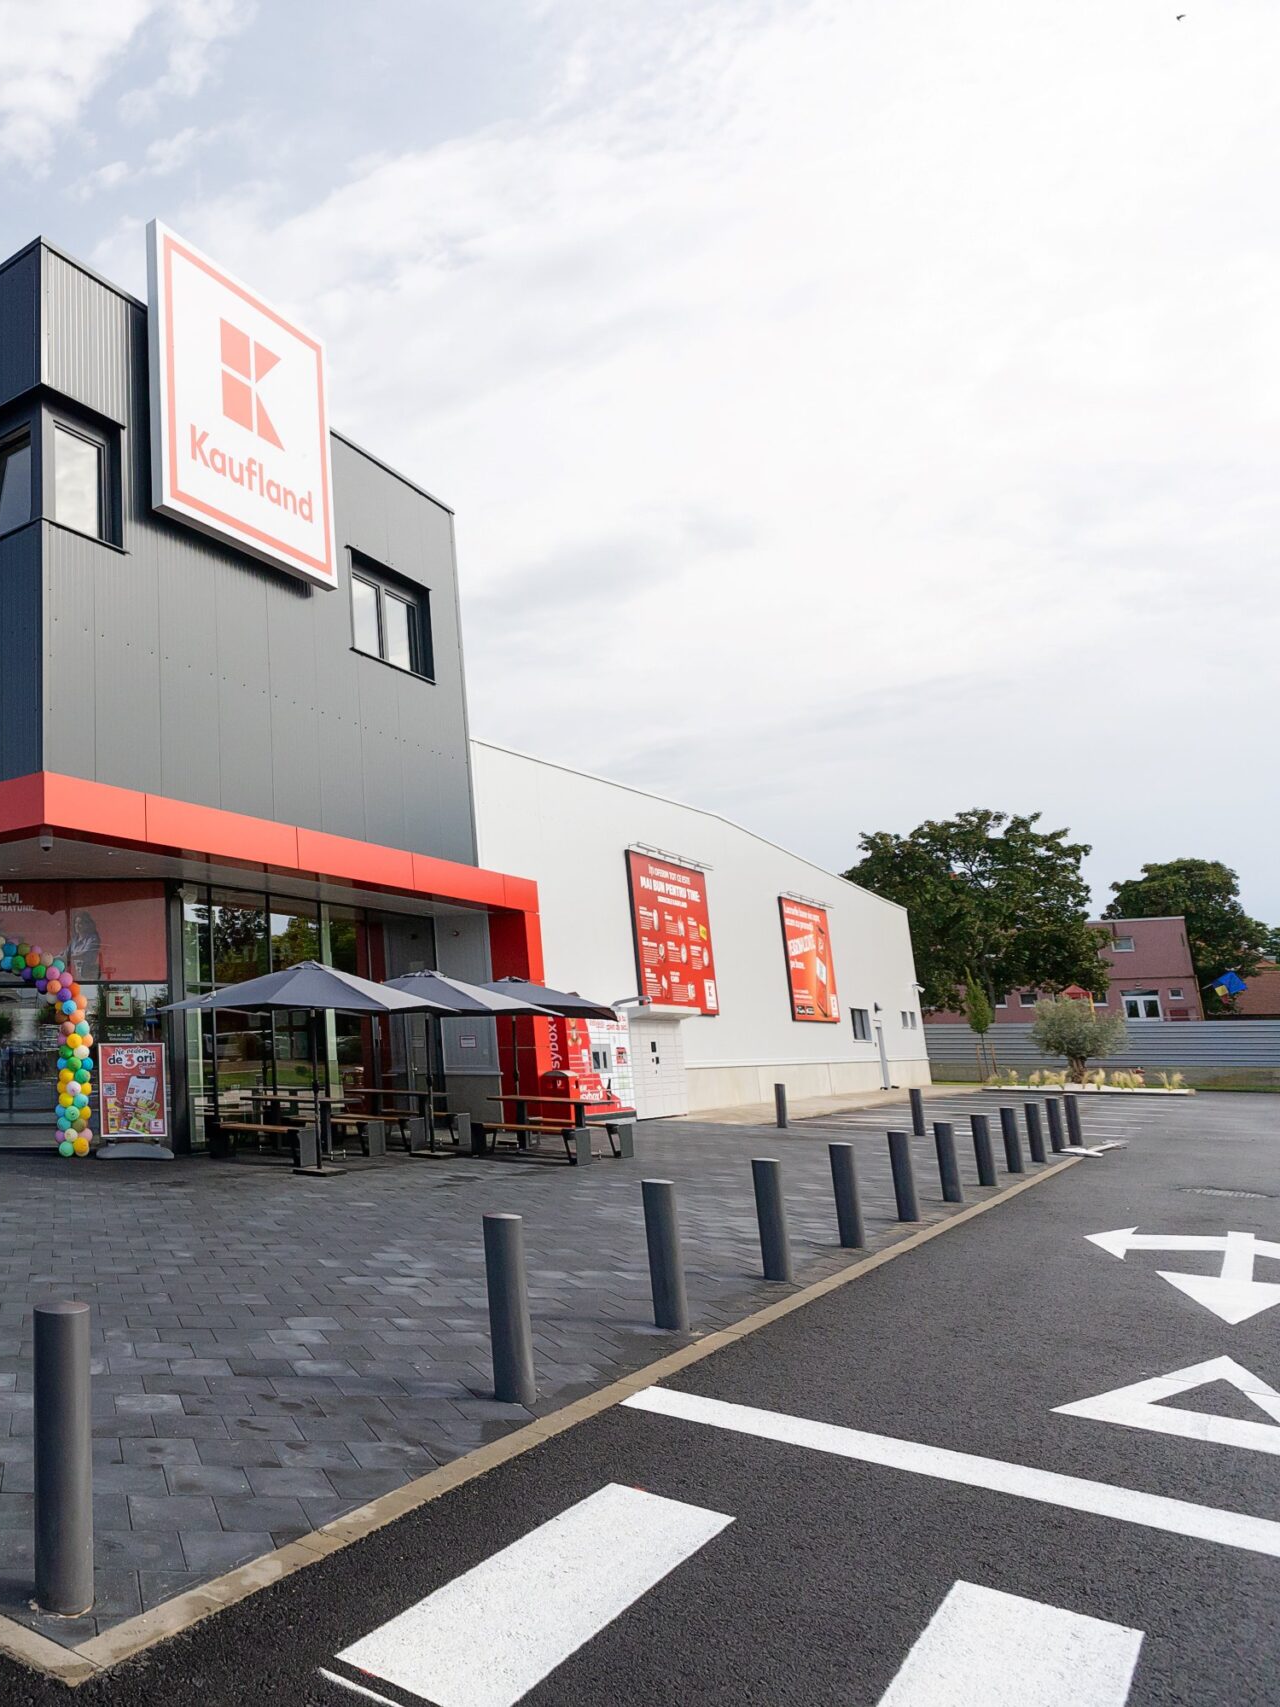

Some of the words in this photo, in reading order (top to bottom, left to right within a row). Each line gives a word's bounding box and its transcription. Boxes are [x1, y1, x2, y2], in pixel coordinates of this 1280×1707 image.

[190, 424, 313, 523] Kaufland
[108, 1055, 123, 1064] de
[124, 1054, 135, 1067] 3
[137, 1052, 155, 1062] ori!
